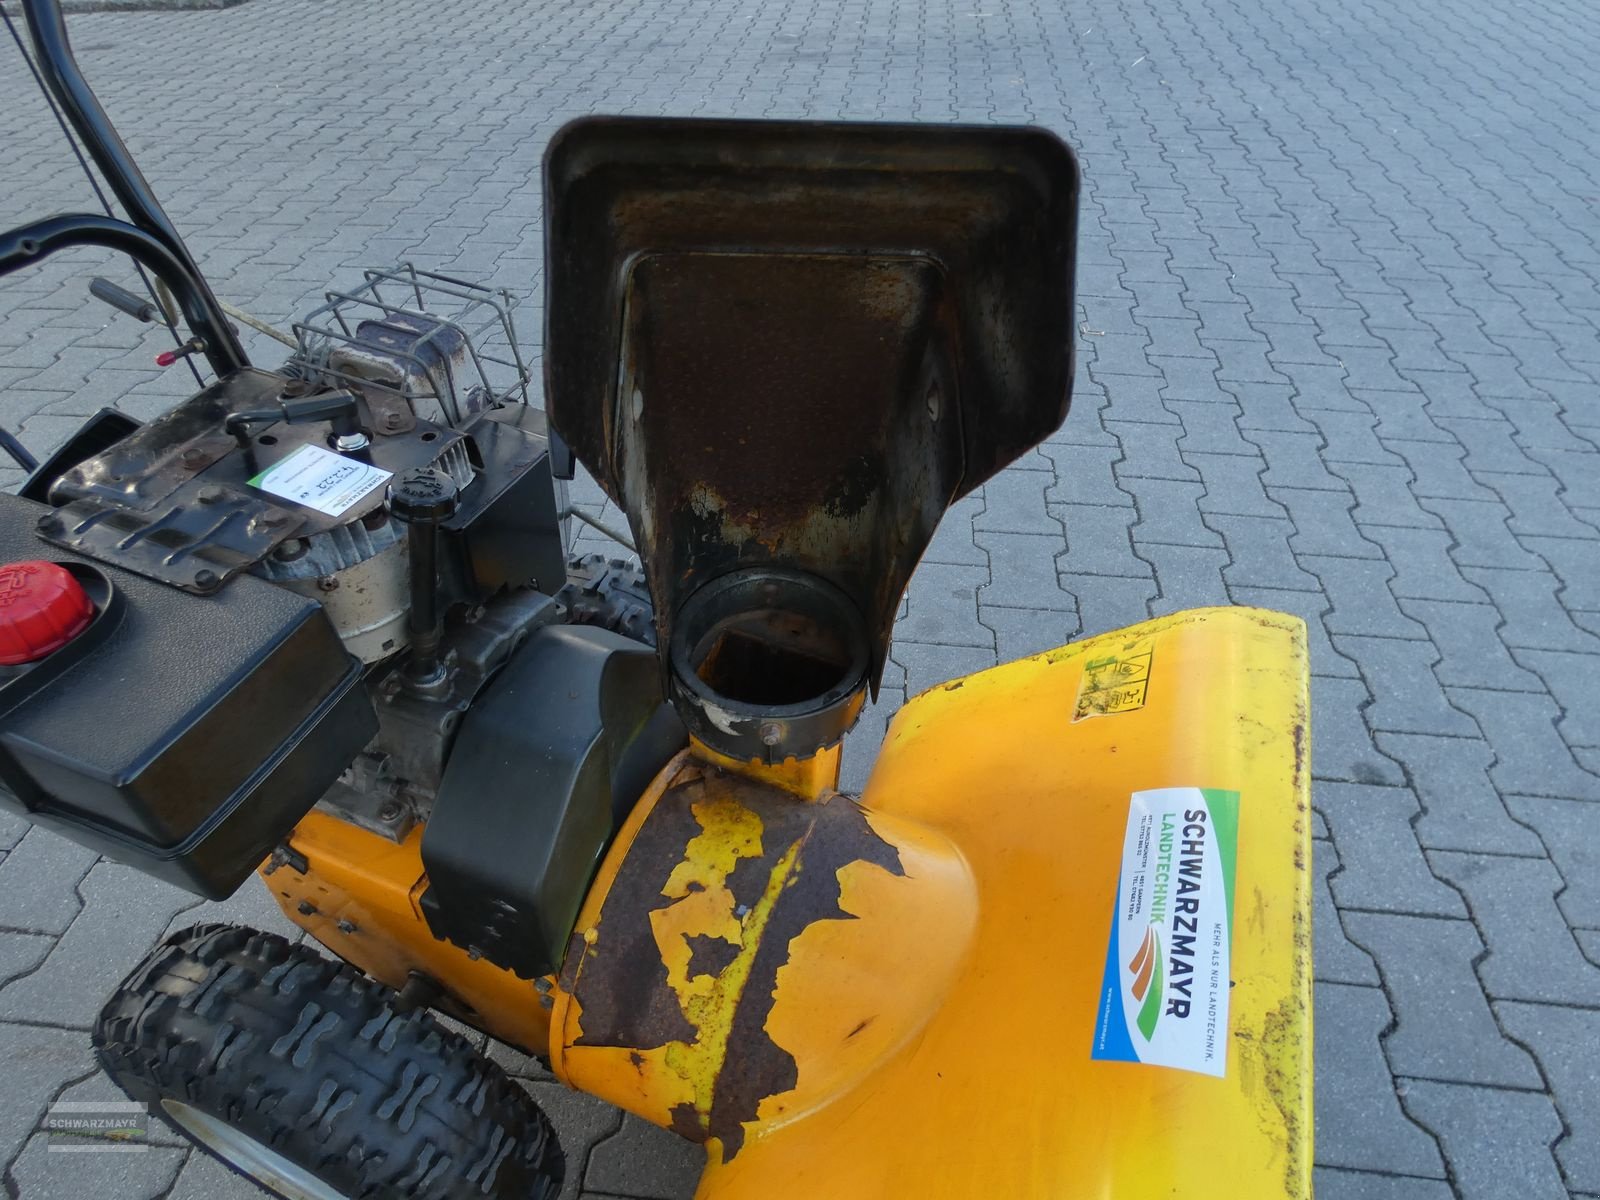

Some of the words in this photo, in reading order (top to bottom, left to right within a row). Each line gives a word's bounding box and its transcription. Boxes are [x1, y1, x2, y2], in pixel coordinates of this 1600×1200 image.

[1149, 812, 1176, 925] LANDTECHNIK
[1135, 888, 1143, 914] GAMPERN
[1165, 809, 1207, 1019] SCHWARZMAYR
[1212, 922, 1221, 947] MEHR
[1211, 950, 1220, 967] ALS
[1209, 969, 1218, 989] NUR
[1099, 987, 1114, 1051] www.schwarzmayr.at
